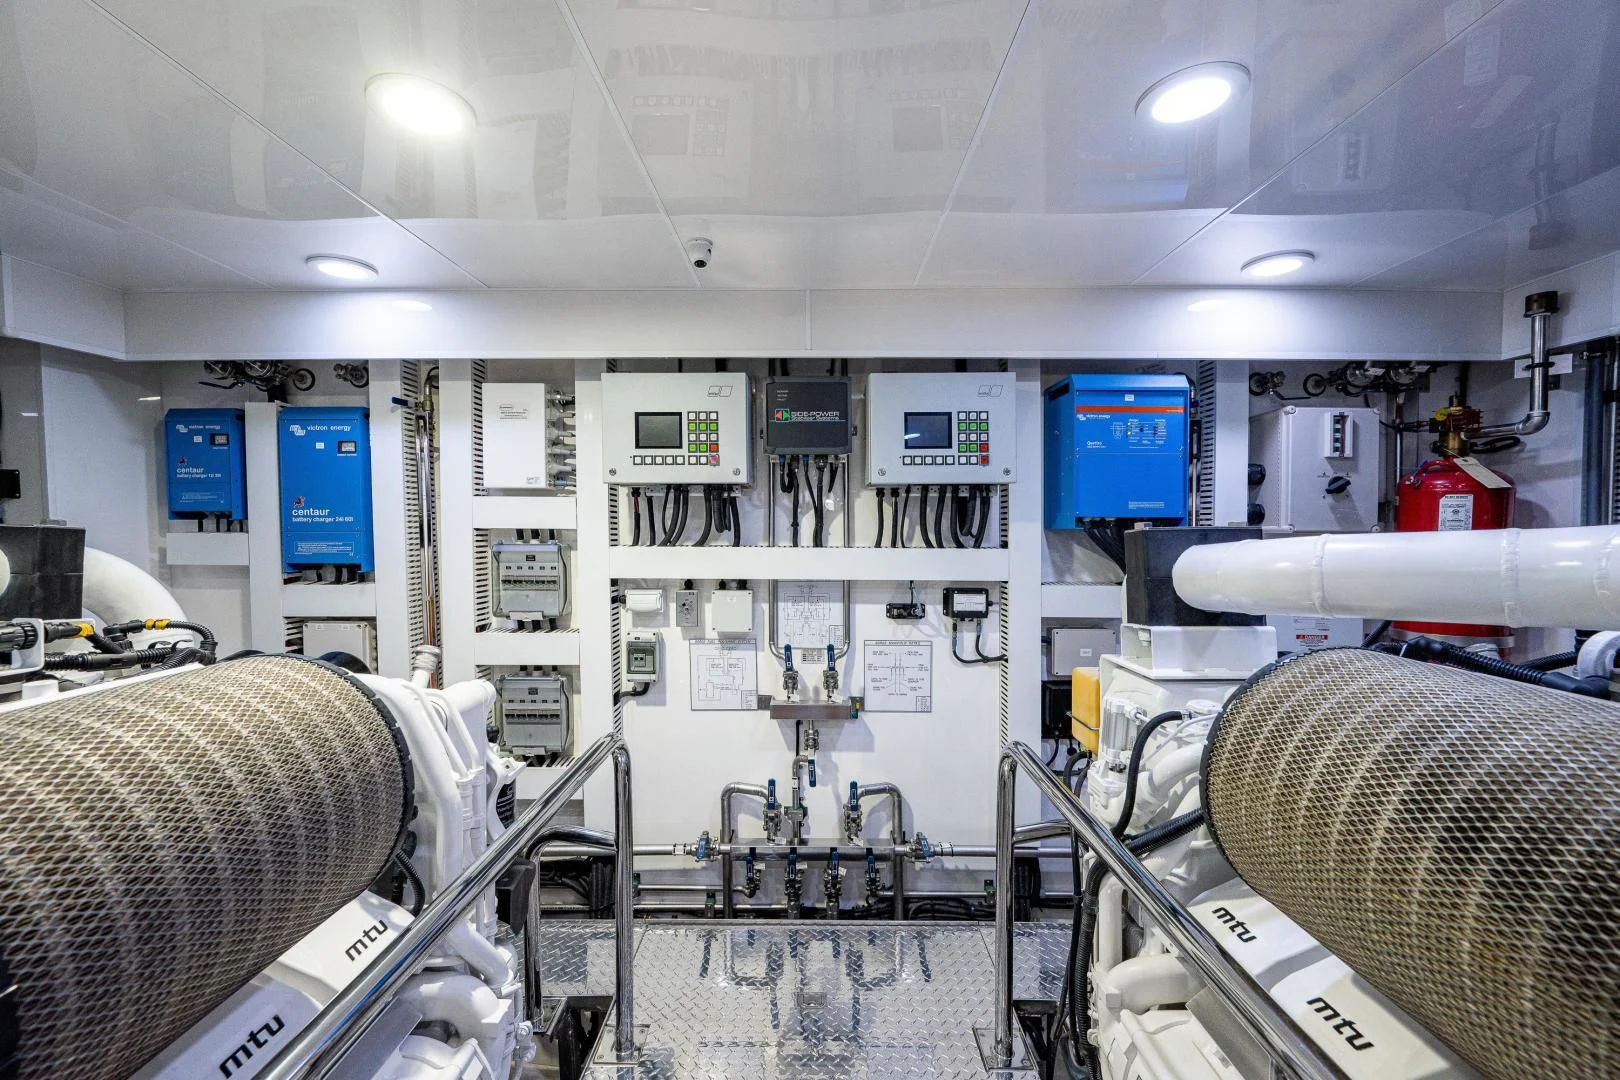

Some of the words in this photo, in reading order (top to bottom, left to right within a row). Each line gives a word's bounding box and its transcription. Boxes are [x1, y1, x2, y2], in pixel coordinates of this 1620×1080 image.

[291, 507, 331, 516] centaur
[344, 919, 389, 962] mtu
[1211, 906, 1257, 943] mtu
[1306, 997, 1375, 1051] mtu
[218, 1014, 286, 1079] mtu
